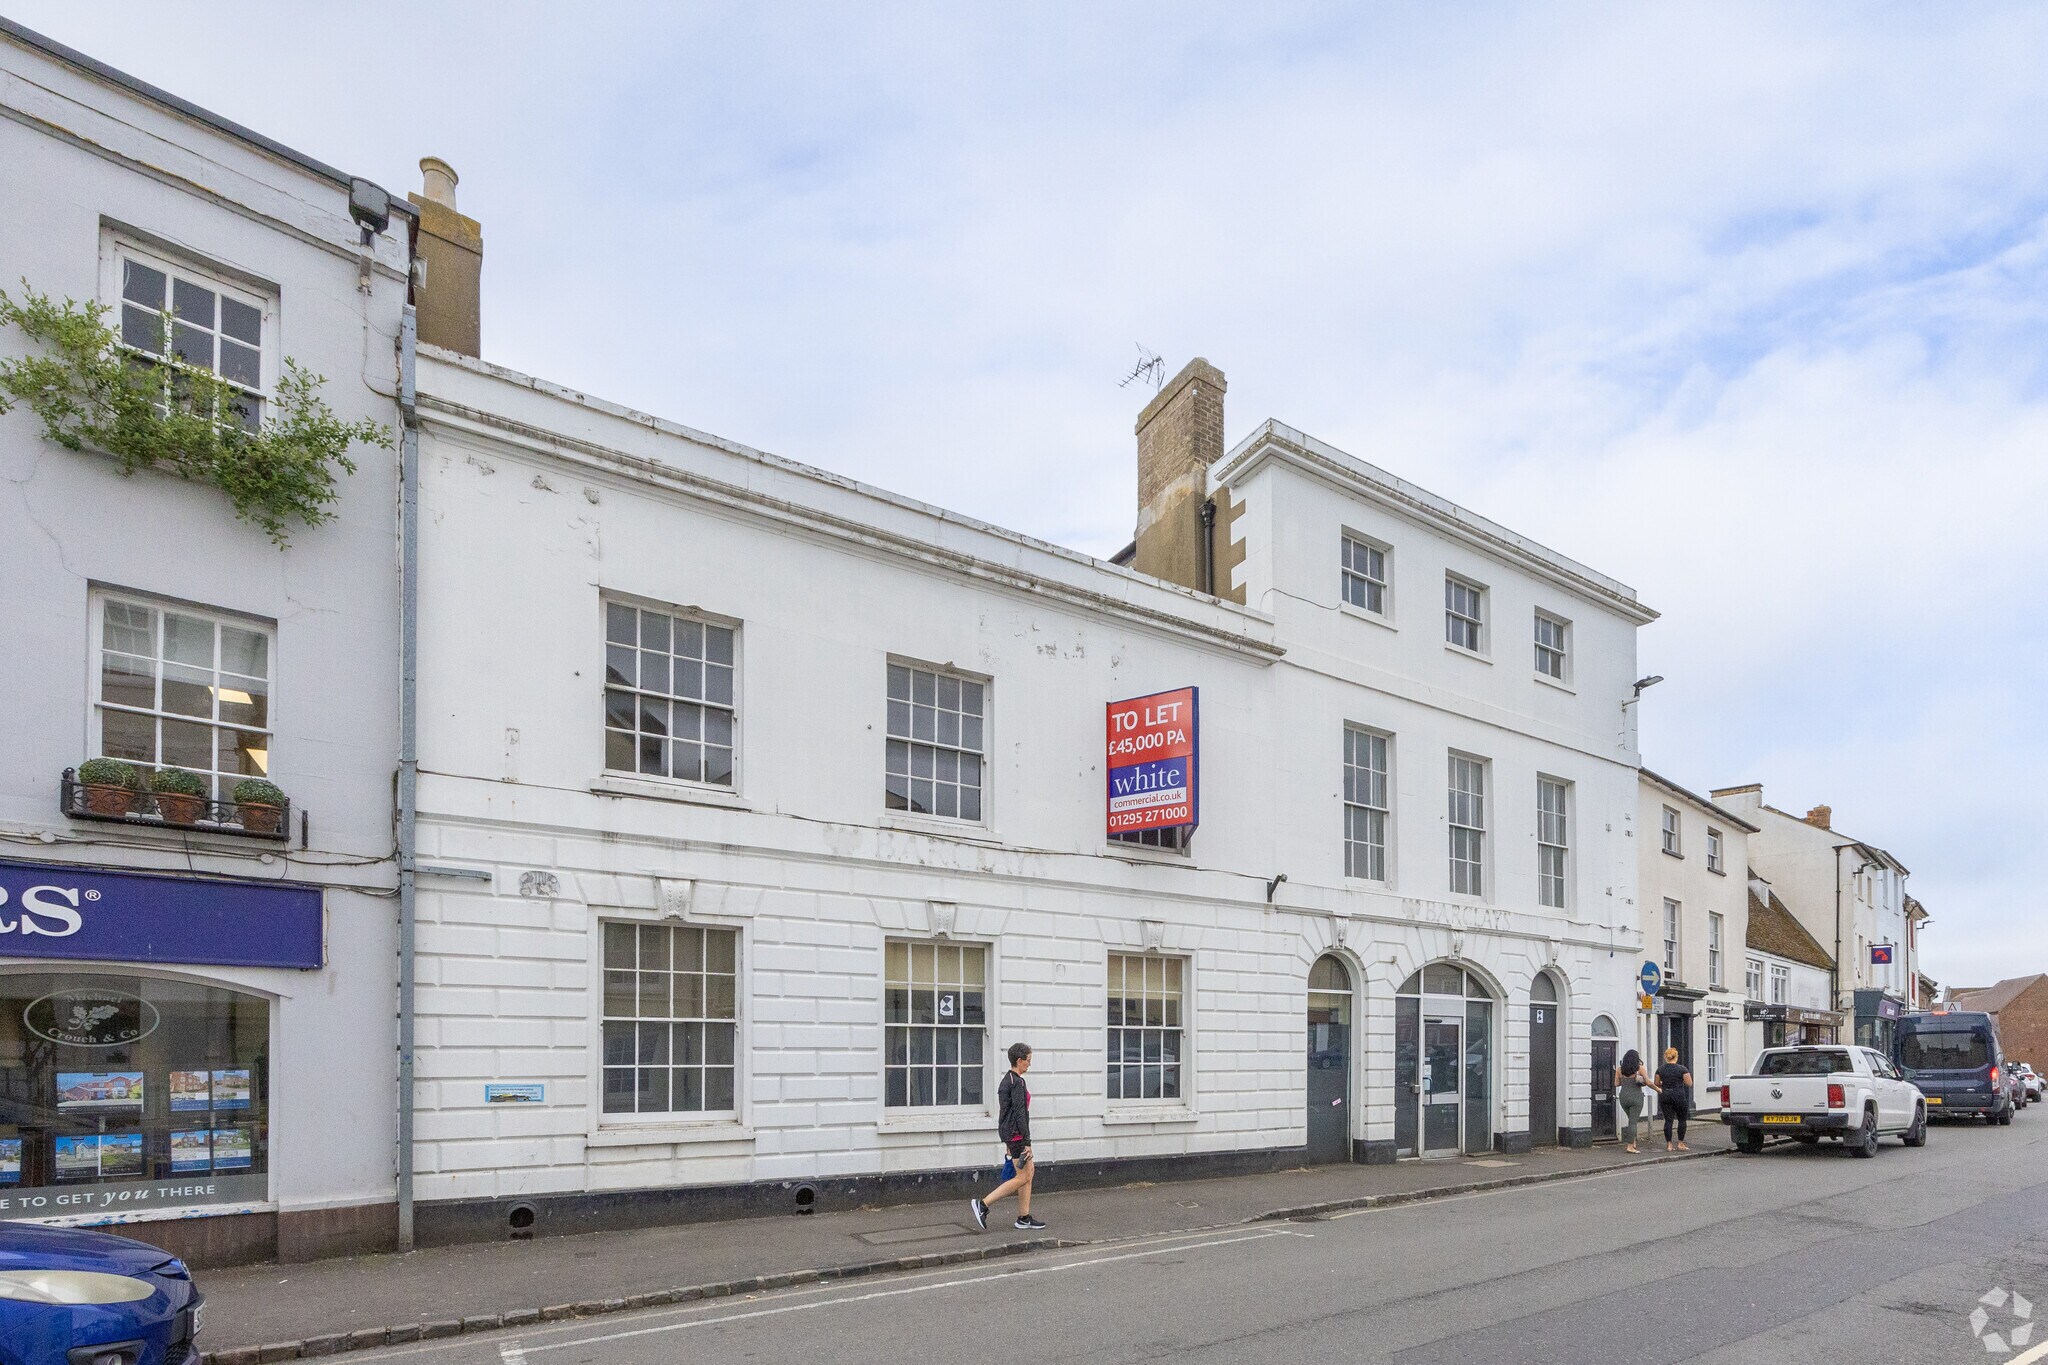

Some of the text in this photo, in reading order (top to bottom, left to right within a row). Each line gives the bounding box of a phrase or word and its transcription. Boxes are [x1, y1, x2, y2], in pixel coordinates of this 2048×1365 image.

[1112, 701, 1183, 732] TO LET
[1108, 728, 1186, 756] £45,000 PA
[1114, 764, 1180, 794] white
[1114, 791, 1182, 809] commercial.co.uk
[1109, 806, 1188, 827] 01295 271000
[47, 1028, 138, 1043] Crouch & Co
[19, 1196, 47, 1208] TO
[56, 1193, 95, 1205] GET
[100, 1189, 151, 1207] you
[157, 1185, 215, 1198] THERE
